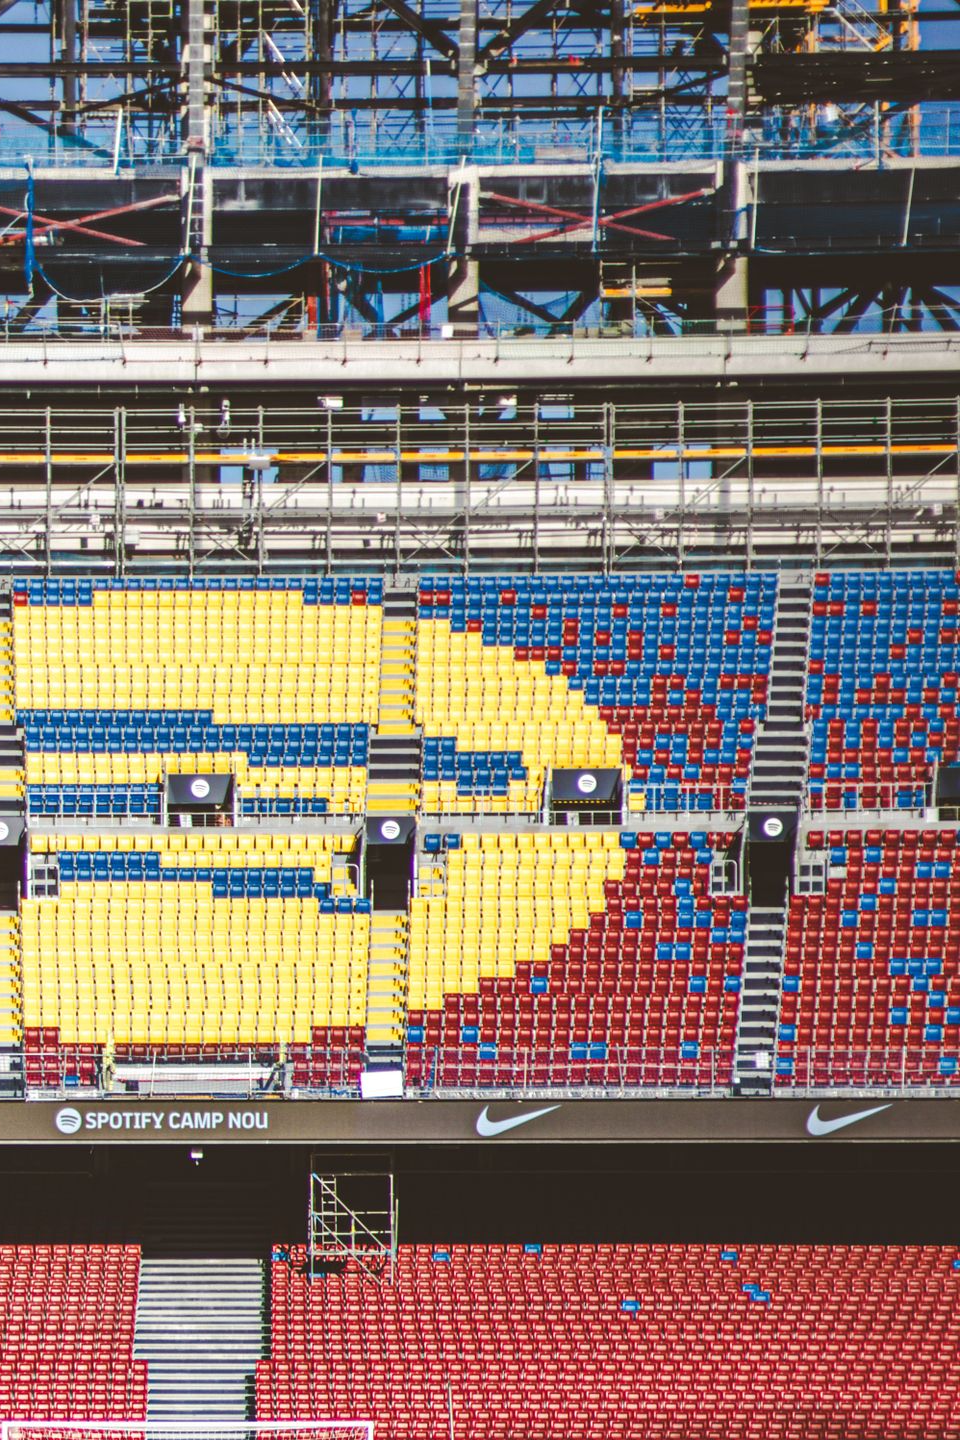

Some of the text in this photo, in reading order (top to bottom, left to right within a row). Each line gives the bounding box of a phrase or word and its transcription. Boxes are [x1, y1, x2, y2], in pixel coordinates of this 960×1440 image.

[85, 1112, 268, 1129] SPOTIFY CAMP NOU
